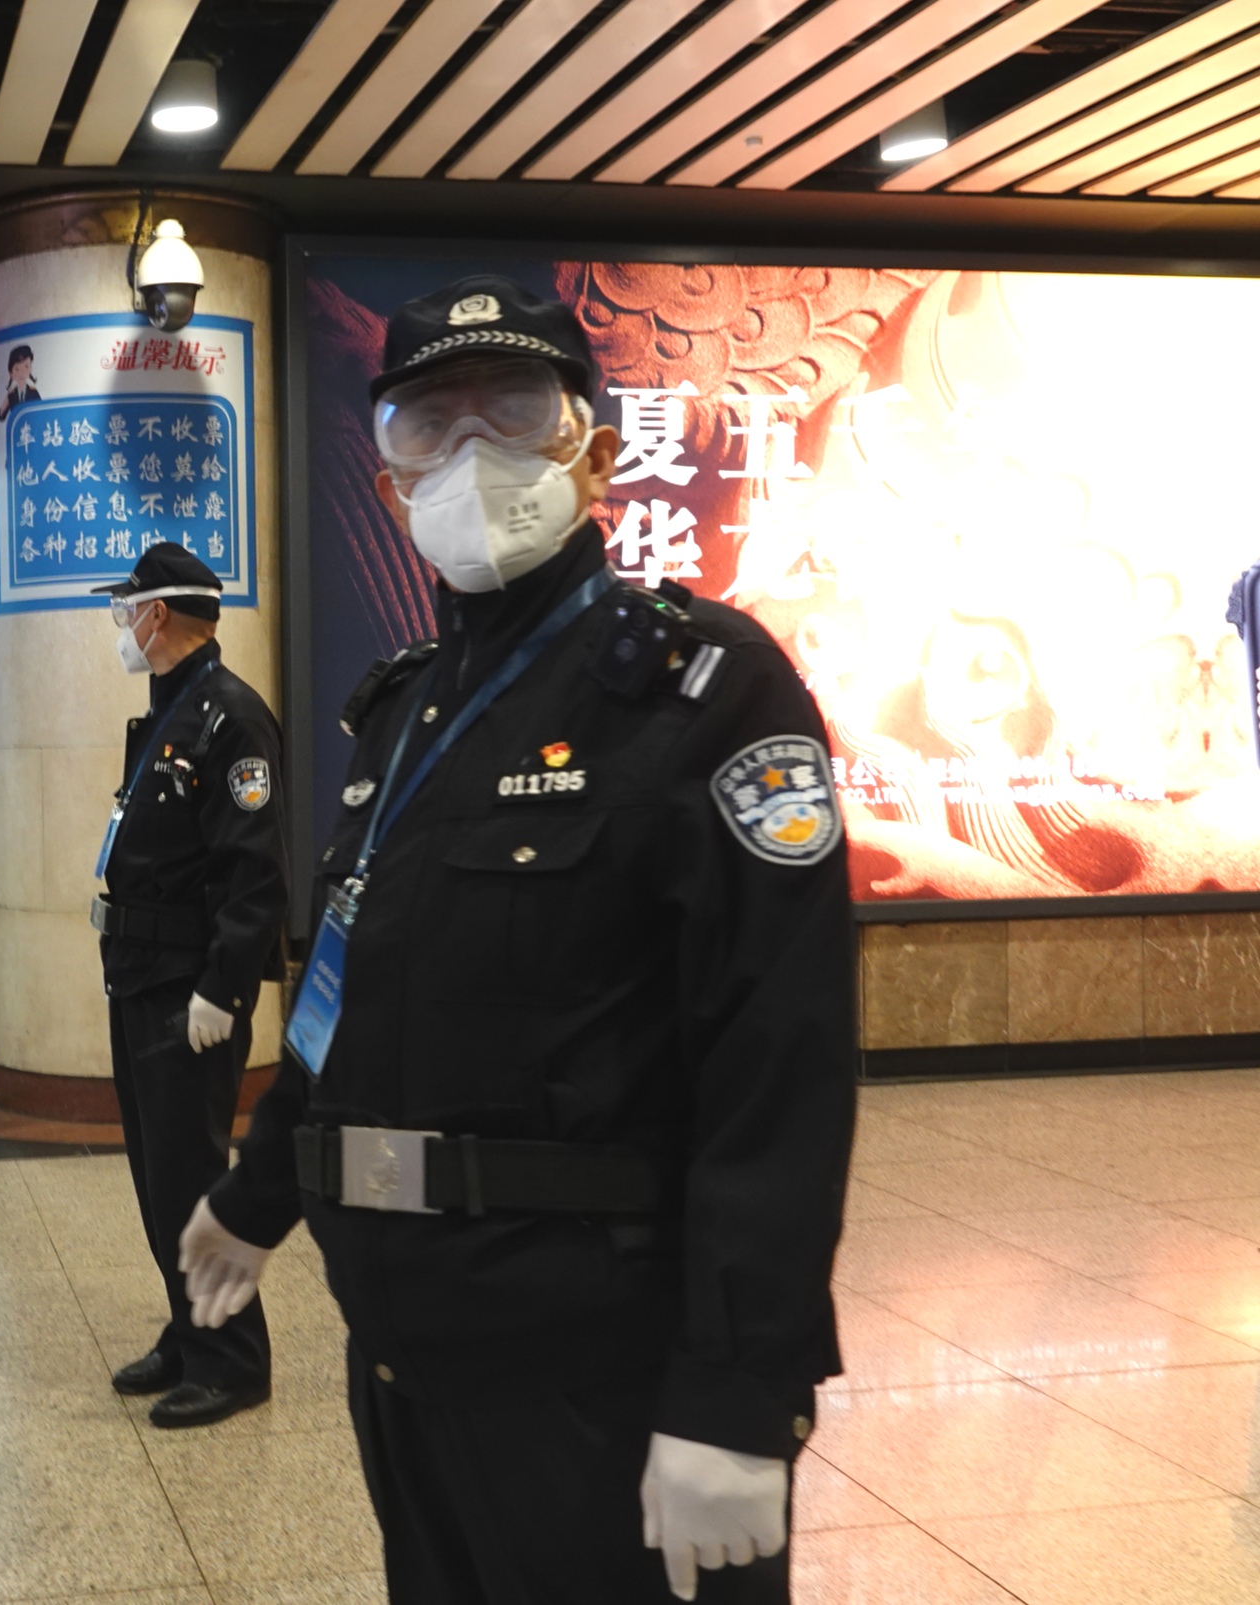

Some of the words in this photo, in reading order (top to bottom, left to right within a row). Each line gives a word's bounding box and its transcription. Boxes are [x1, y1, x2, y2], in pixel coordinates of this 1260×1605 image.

[101, 339, 226, 376] 温馨提示
[16, 414, 225, 454] 车站验票不收票
[17, 451, 227, 487] 他人收票您莫给
[19, 490, 227, 528] 身份信息不泄露
[497, 769, 586, 797] 011795
